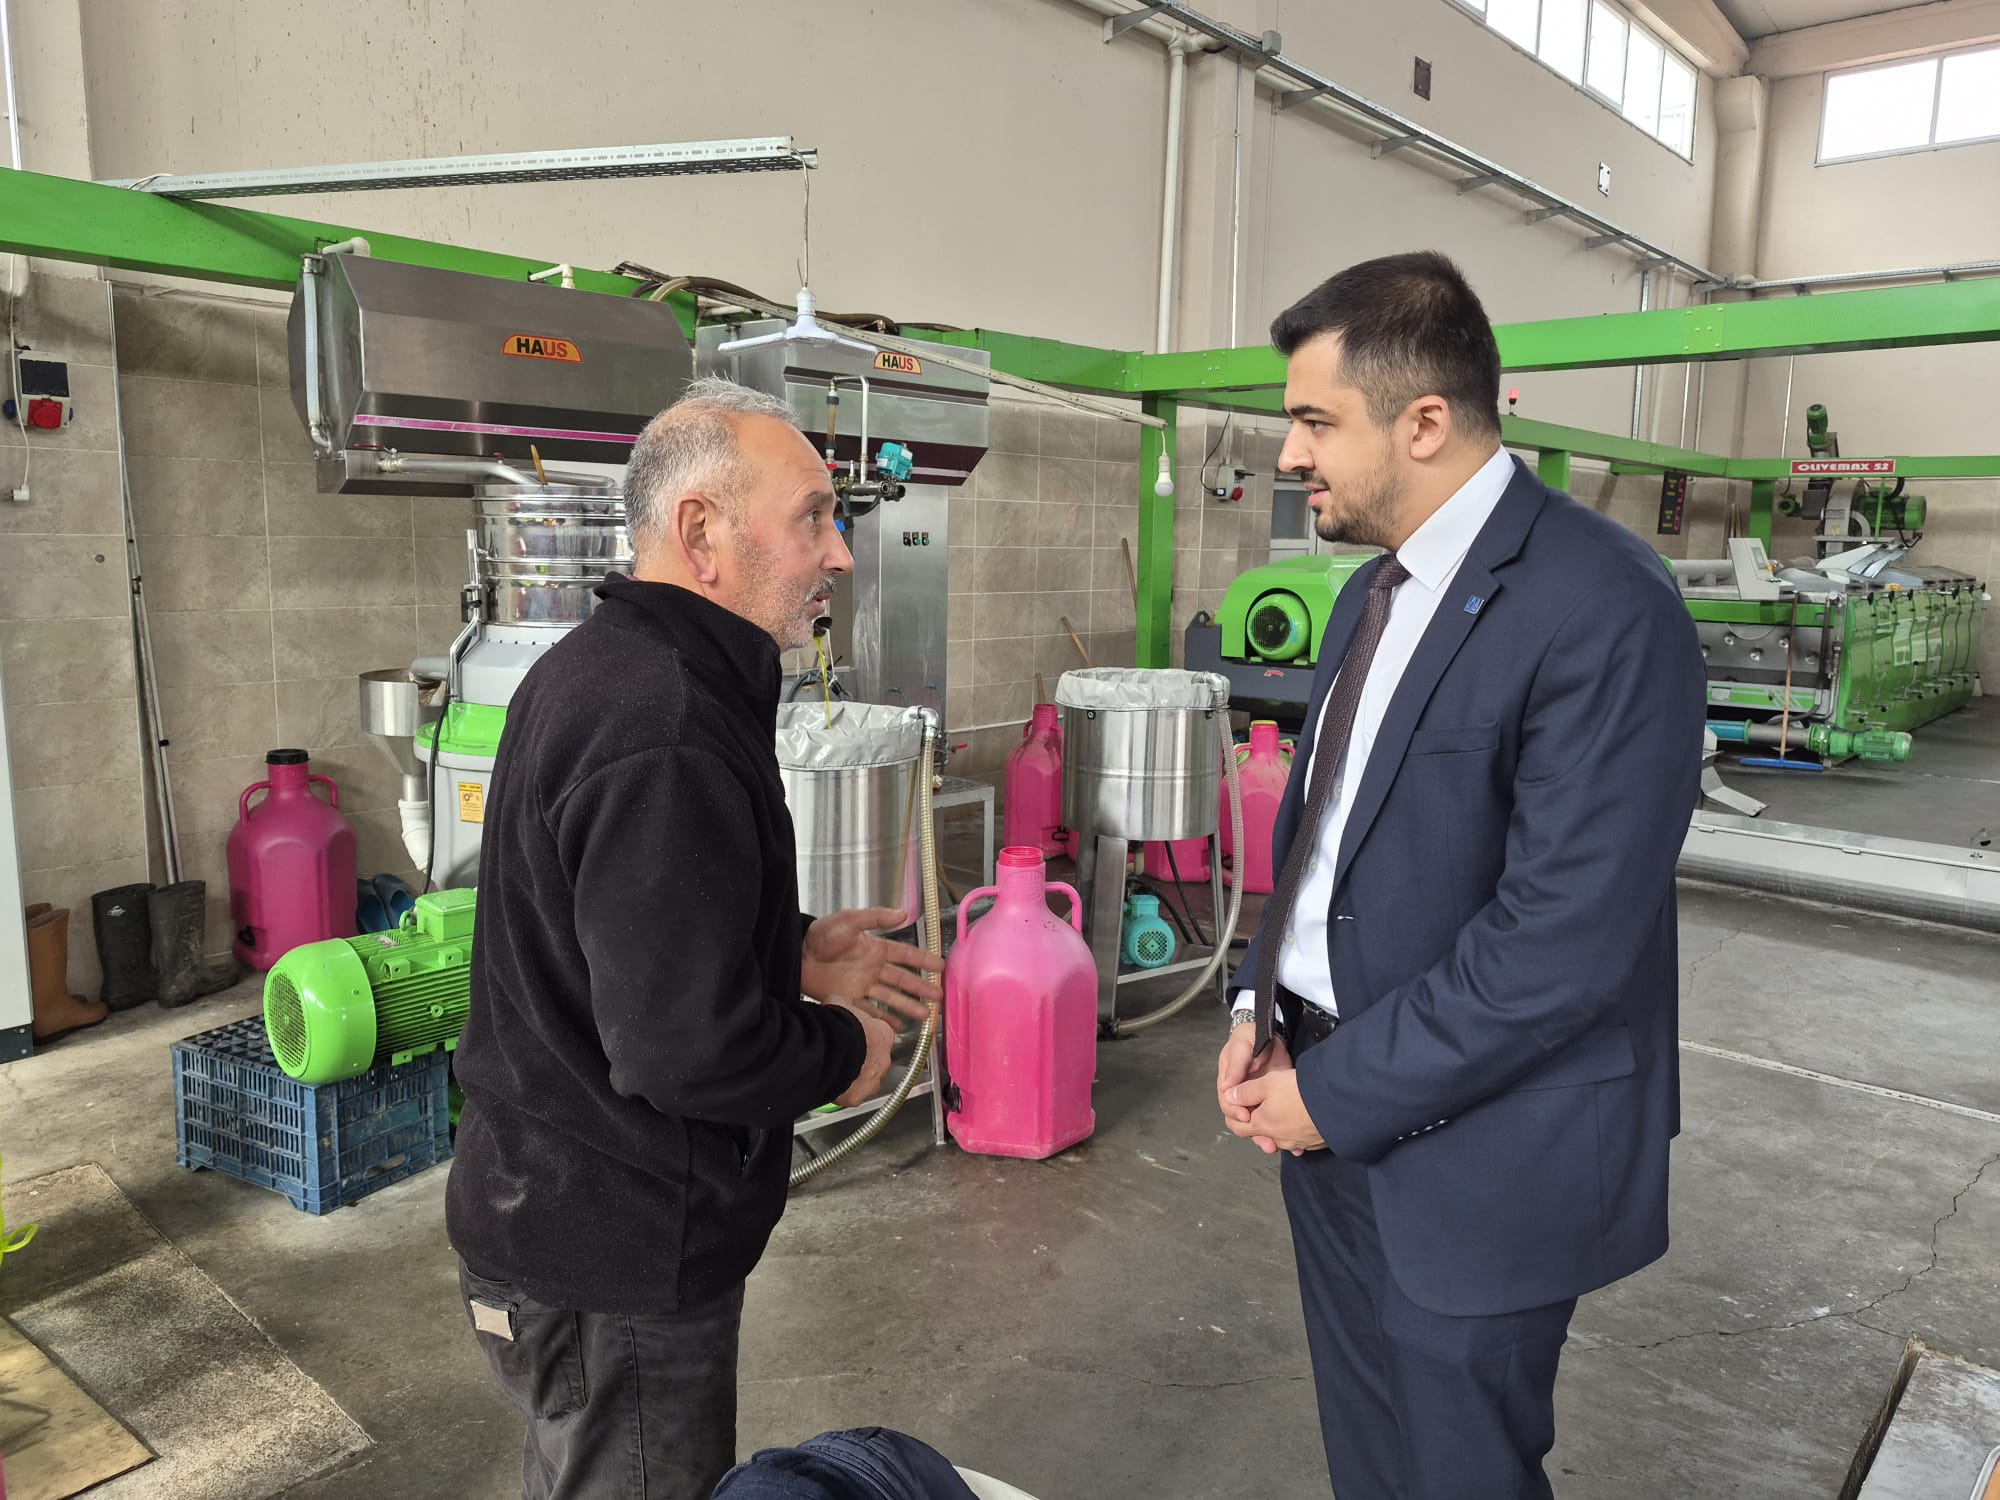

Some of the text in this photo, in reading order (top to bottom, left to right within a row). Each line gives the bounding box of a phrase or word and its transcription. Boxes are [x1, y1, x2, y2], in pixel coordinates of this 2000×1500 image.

[516, 337, 568, 358] HAUS
[882, 354, 914, 371] HAUS
[1797, 463, 1870, 472] OLIVEMAX
